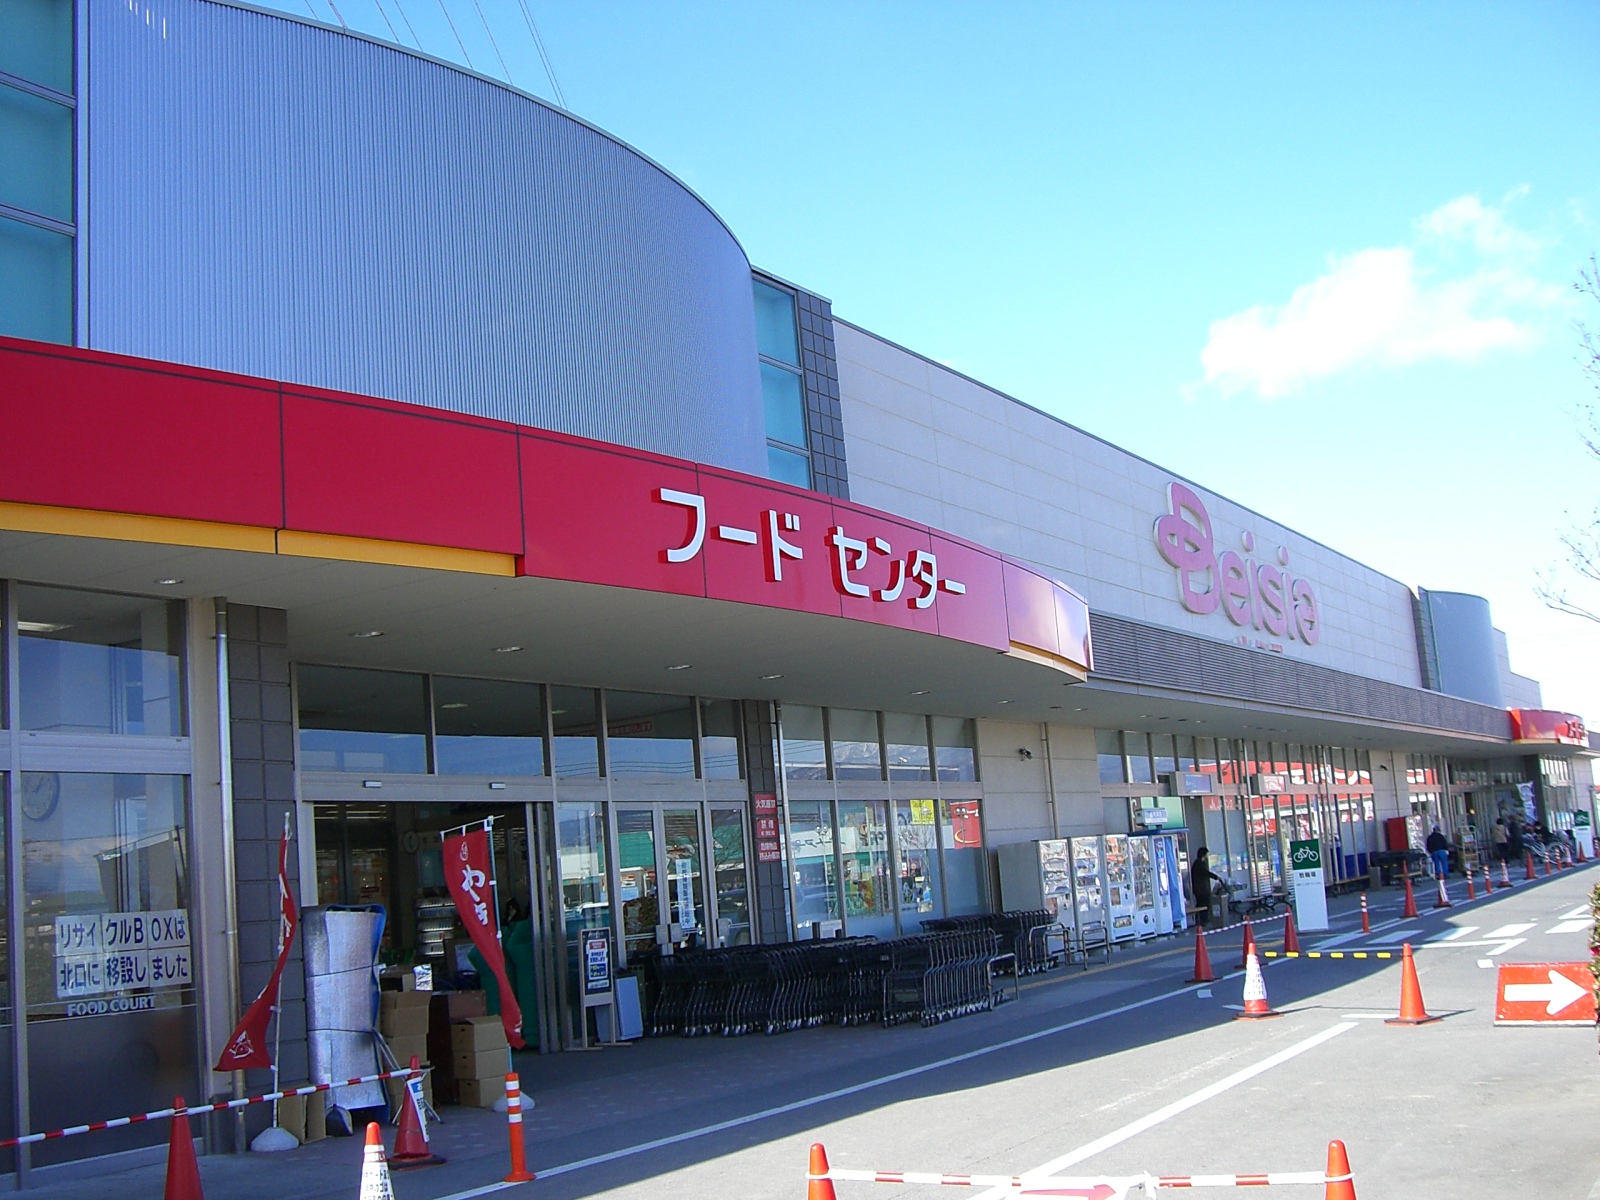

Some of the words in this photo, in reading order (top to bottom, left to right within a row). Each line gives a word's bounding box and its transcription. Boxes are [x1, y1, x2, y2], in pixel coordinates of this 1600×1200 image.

[655, 487, 803, 582] フード
[827, 525, 966, 610] センター
[1153, 481, 1321, 646] Beisia
[60, 916, 185, 949] リサイクルBOXは
[60, 953, 188, 991] 北口に移設しました
[67, 1001, 108, 1017] FOOD
[109, 996, 156, 1013] COURT
